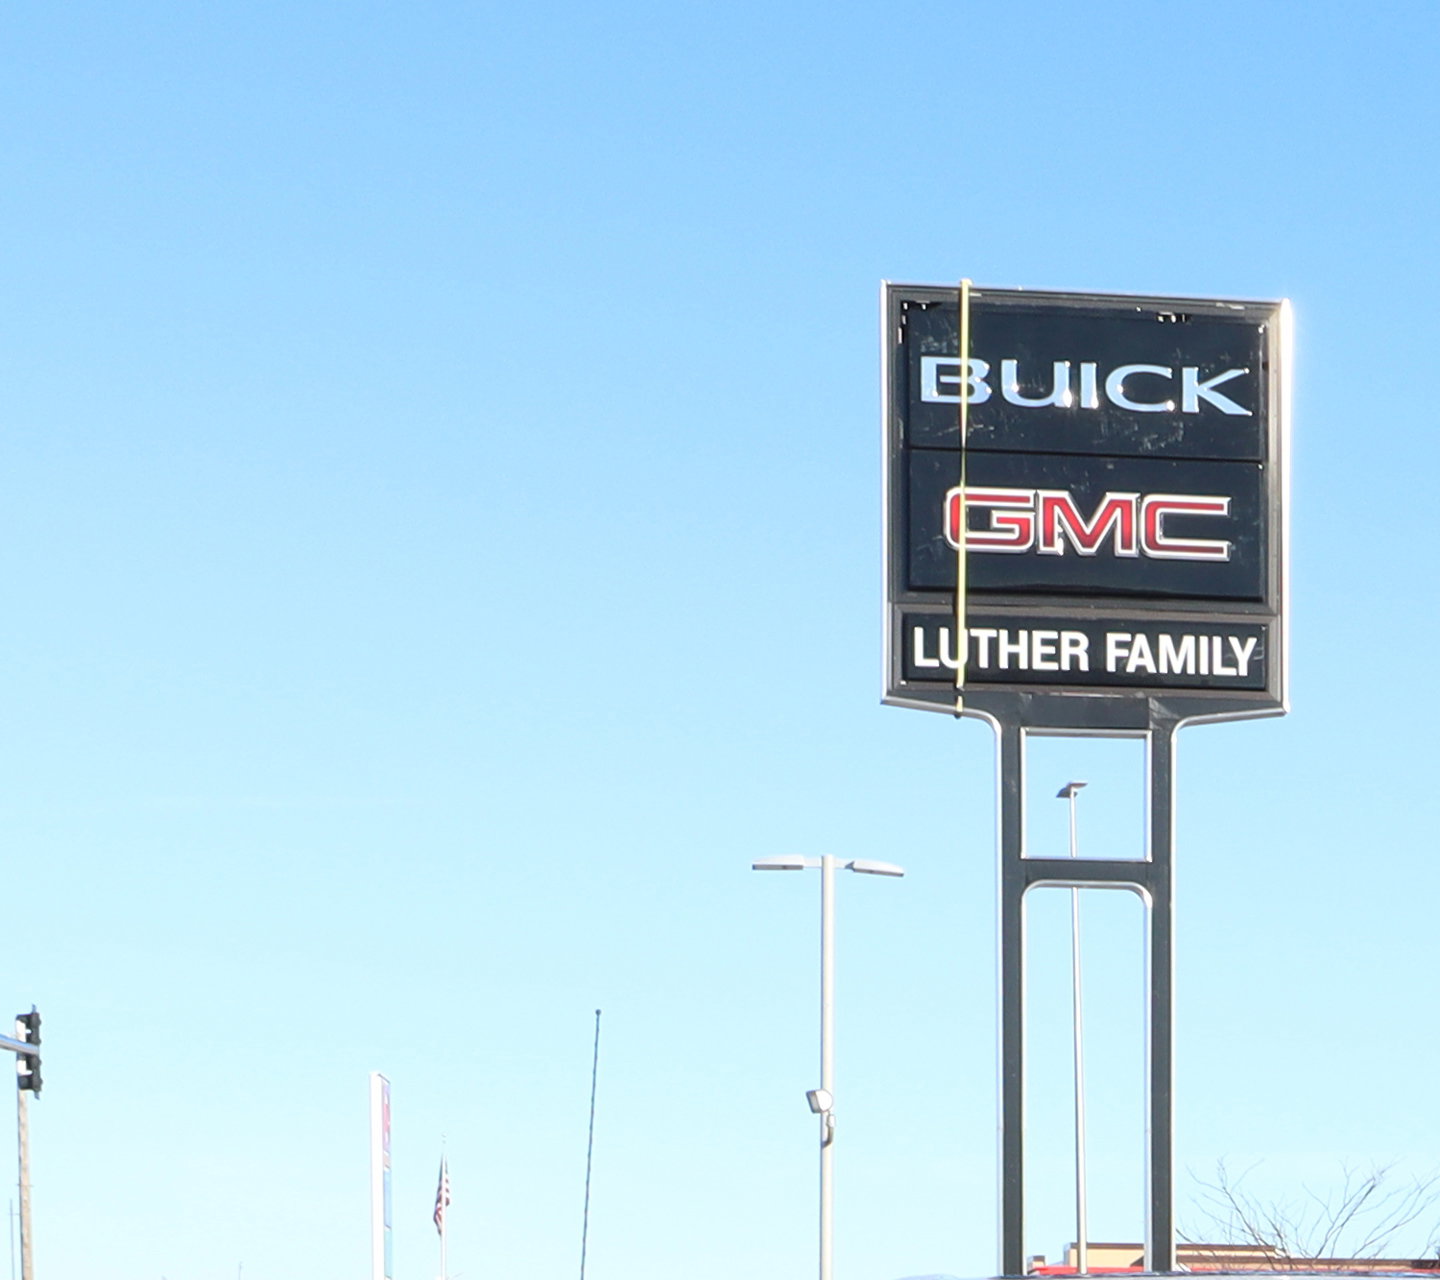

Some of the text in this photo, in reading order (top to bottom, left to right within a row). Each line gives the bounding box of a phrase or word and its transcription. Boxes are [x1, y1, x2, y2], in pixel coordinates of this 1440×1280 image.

[919, 355, 1253, 415] BUICK
[943, 485, 1231, 562] GMC
[913, 626, 1257, 677] LUTHER FAMILY
